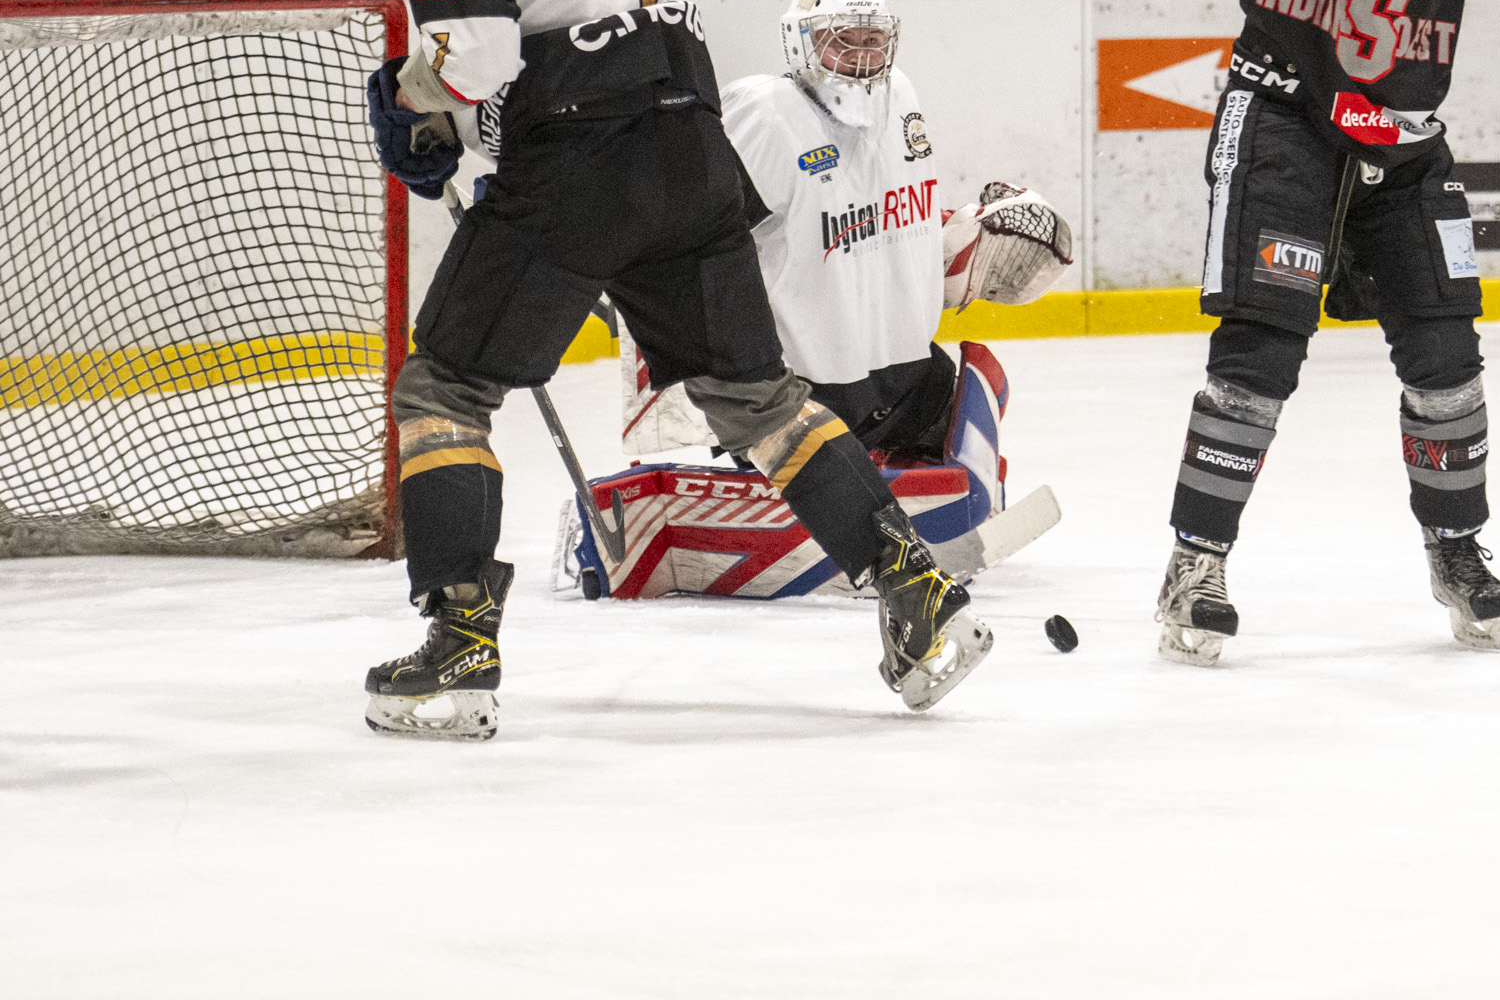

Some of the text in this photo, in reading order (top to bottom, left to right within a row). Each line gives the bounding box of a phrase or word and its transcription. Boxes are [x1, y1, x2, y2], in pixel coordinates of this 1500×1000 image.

[1231, 53, 1300, 94] CCM
[801, 147, 838, 167] MIX
[1273, 242, 1322, 275] KTM
[1196, 451, 1256, 472] BANNAT
[674, 478, 781, 500] CCM
[880, 522, 903, 539] CCM
[439, 649, 490, 685] CCM
